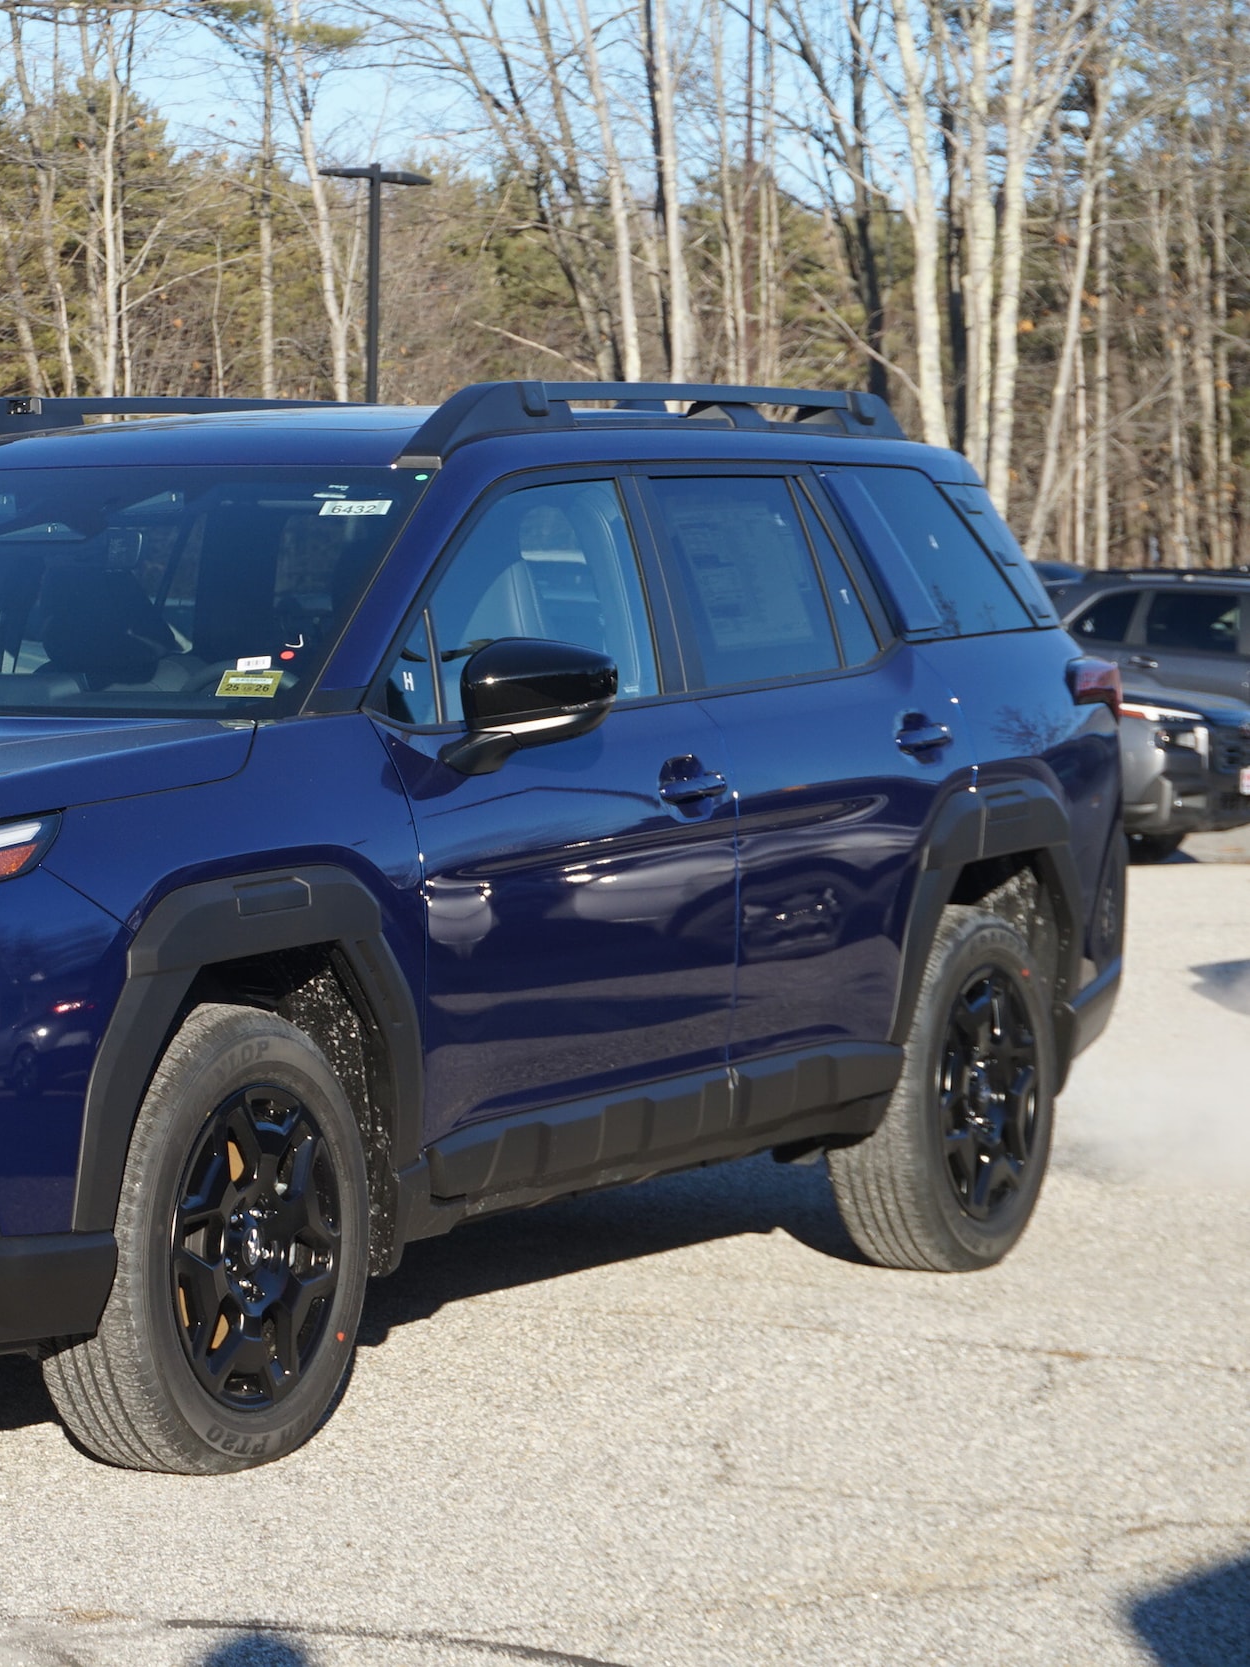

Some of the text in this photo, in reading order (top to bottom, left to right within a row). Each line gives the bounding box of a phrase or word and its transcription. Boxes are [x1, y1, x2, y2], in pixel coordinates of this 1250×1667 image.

[331, 504, 377, 514] 6432
[225, 684, 270, 693] 25 26
[205, 1423, 270, 1457] PT20
